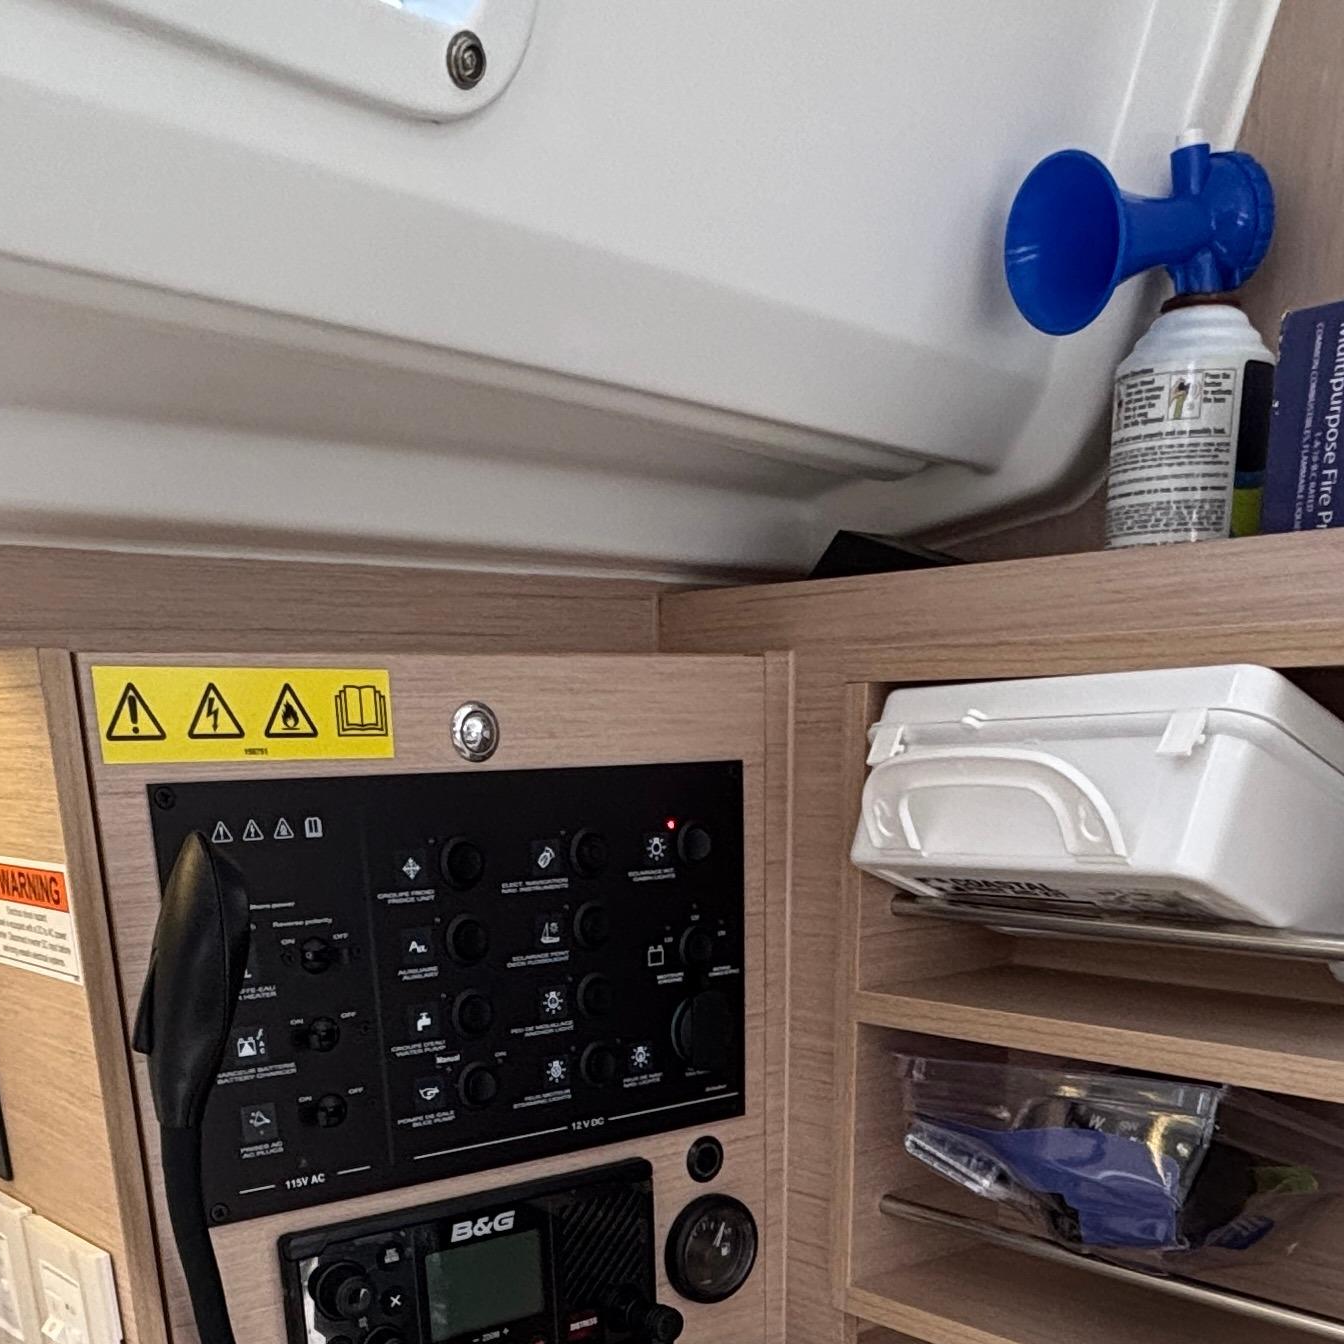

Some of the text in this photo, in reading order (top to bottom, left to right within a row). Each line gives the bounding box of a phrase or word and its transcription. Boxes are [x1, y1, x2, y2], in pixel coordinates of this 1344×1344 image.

[1318, 468, 1338, 507] Fire
[285, 1173, 326, 1190] 115V AC
[451, 1210, 516, 1243] B&G
